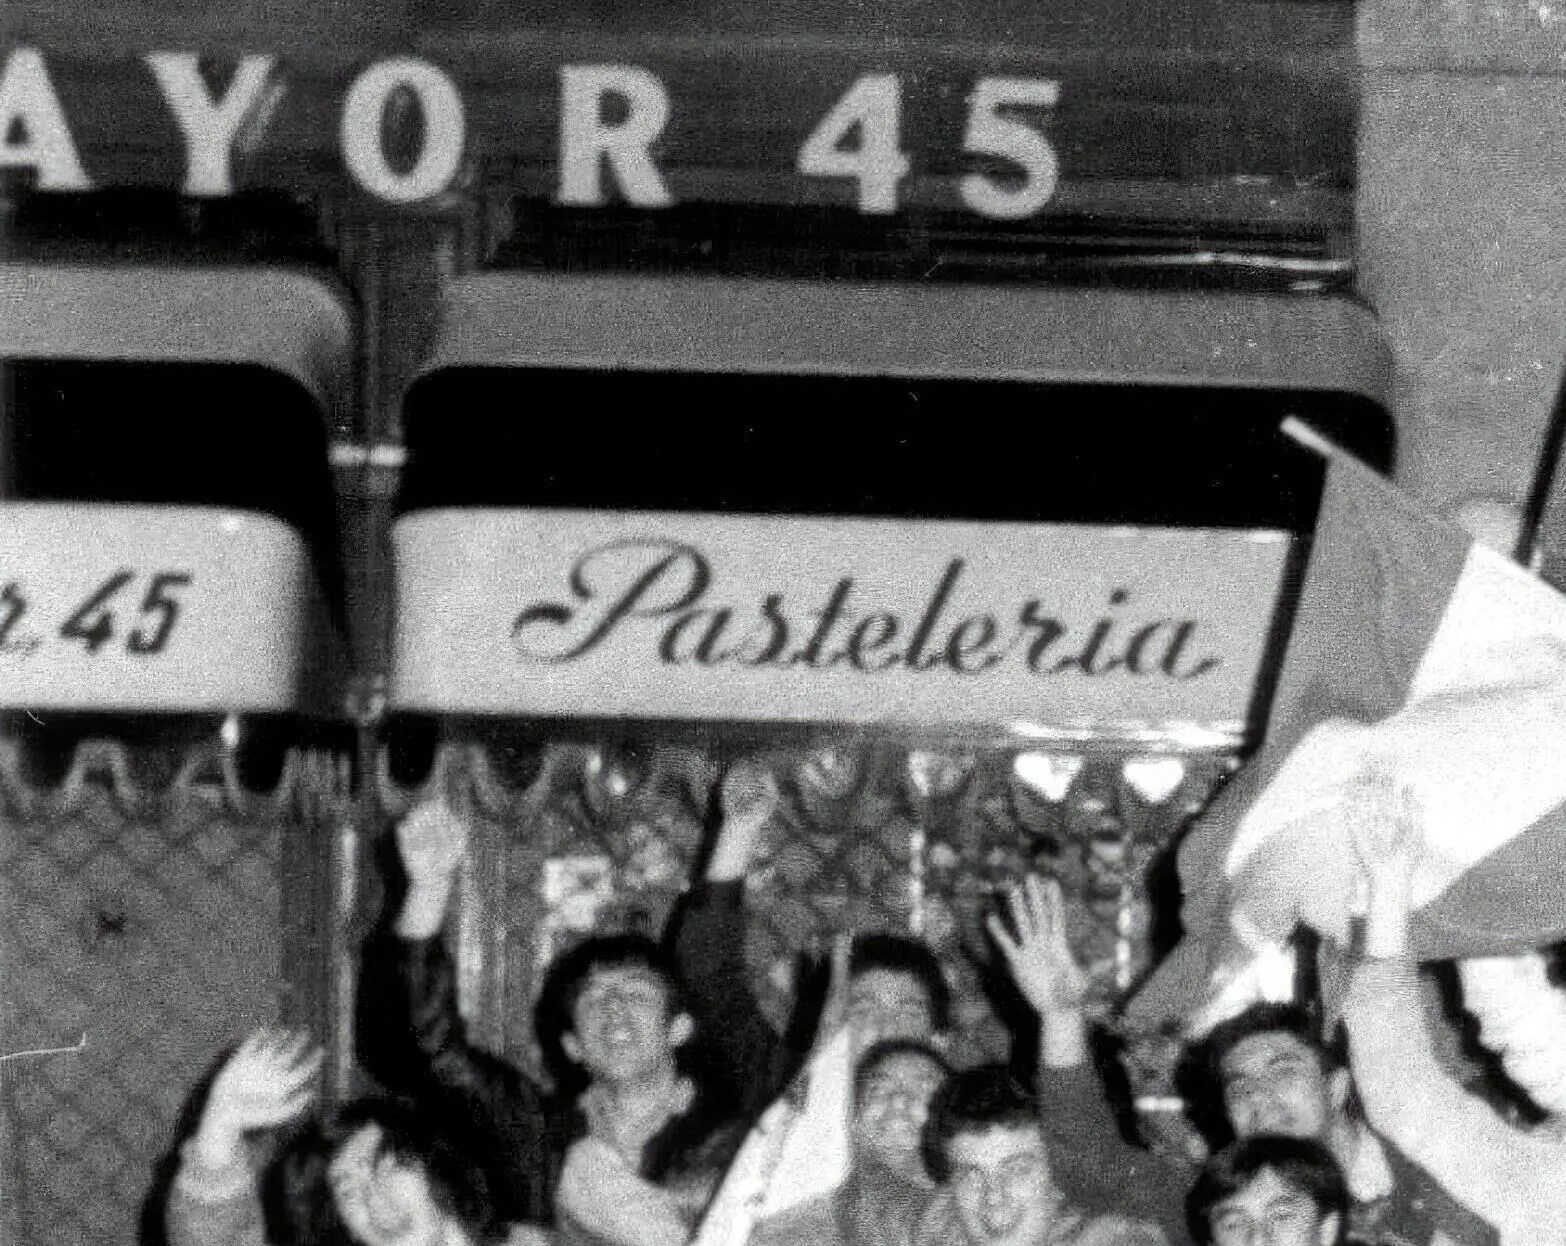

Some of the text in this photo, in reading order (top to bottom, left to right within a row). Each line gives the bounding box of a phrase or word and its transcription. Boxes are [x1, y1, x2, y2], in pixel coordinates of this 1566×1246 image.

[0, 46, 1062, 222] AYOR 45
[60, 566, 193, 654] 45
[511, 537, 1223, 680] Pasteleria
